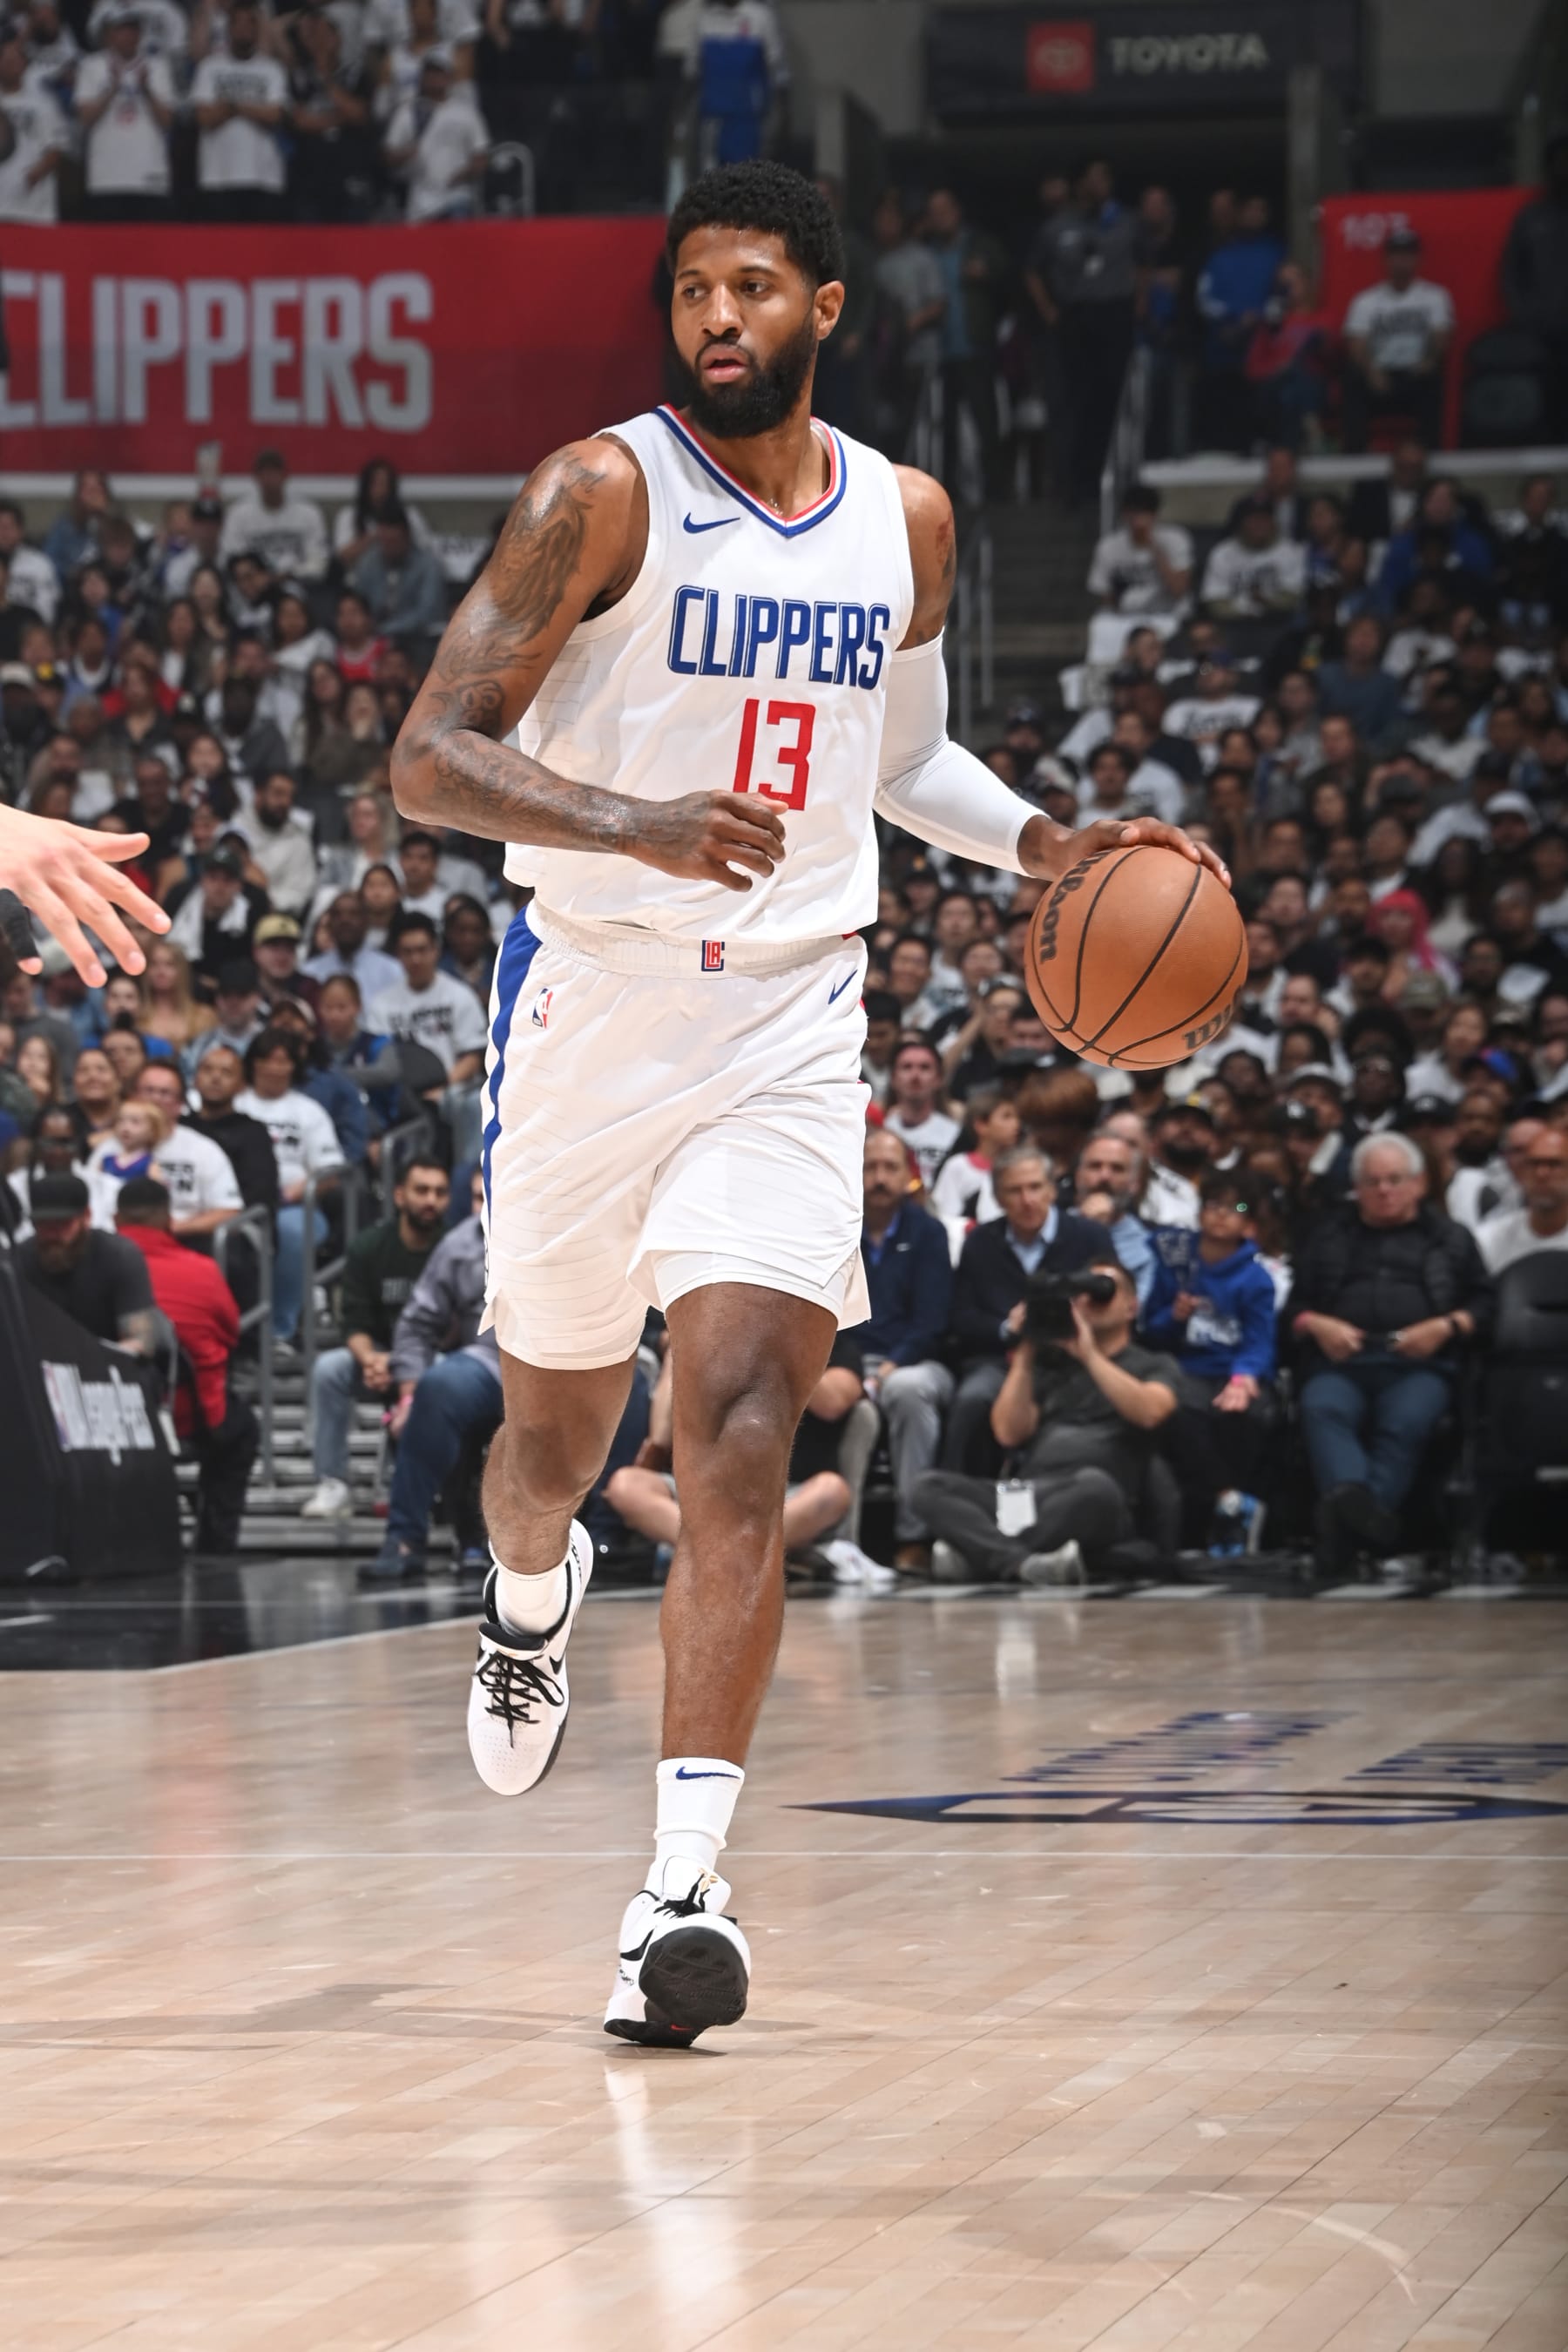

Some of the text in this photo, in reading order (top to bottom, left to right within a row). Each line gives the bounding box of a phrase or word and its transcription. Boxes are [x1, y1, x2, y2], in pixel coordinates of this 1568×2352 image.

[1110, 33, 1269, 76] TOYOTA
[0, 270, 433, 433] CLIPPERS
[667, 585, 890, 690] CLIPPERS
[733, 699, 816, 811] 13
